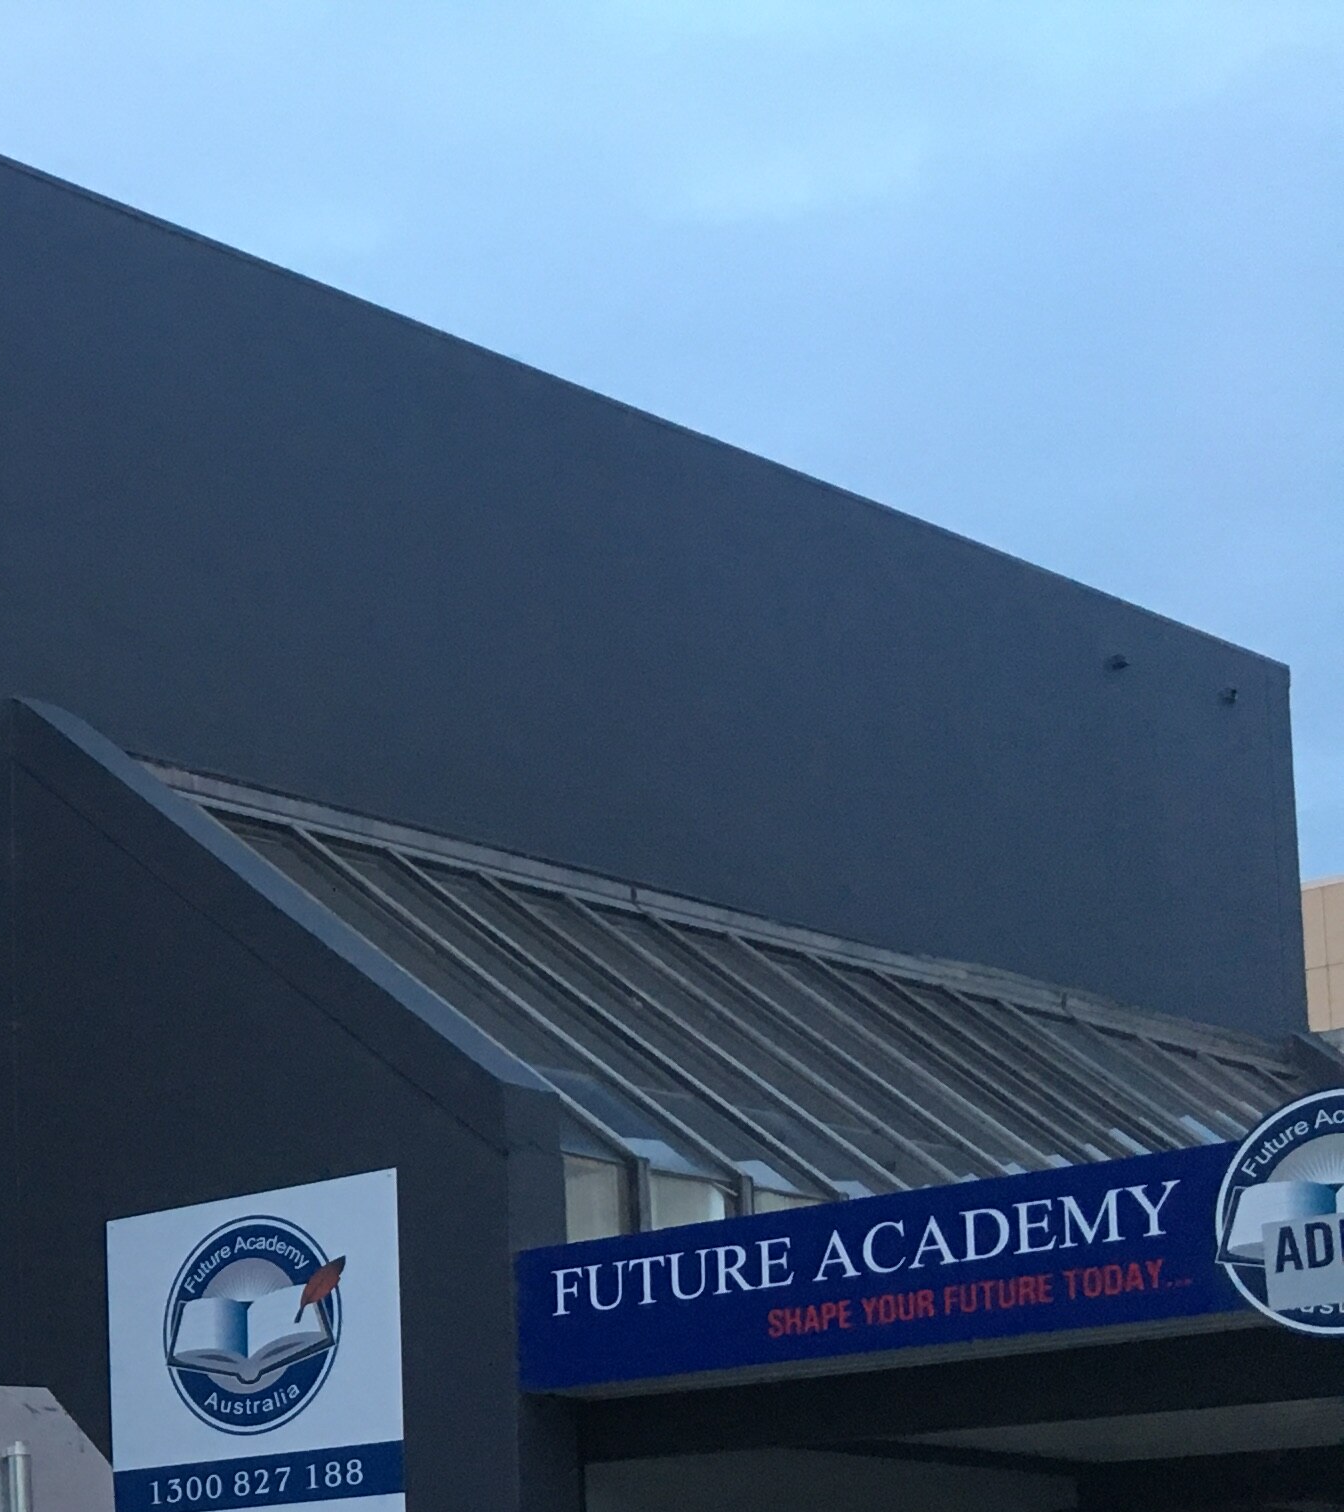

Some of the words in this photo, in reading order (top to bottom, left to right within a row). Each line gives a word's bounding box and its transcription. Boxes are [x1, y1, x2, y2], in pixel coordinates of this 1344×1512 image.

[1241, 1119, 1309, 1178] Future
[183, 1243, 232, 1294] Future
[234, 1234, 310, 1271] Academy
[551, 1237, 795, 1317] FUTURE
[813, 1179, 1181, 1281] ACADEMY
[1275, 1218, 1344, 1274] AD
[767, 1299, 853, 1338] SHAPE
[861, 1288, 936, 1325] YOUR
[944, 1273, 1054, 1316] FUTURE
[203, 1382, 301, 1416] Australia
[149, 1473, 223, 1505] 1300
[233, 1467, 292, 1498] 827
[305, 1458, 364, 1490] 188
